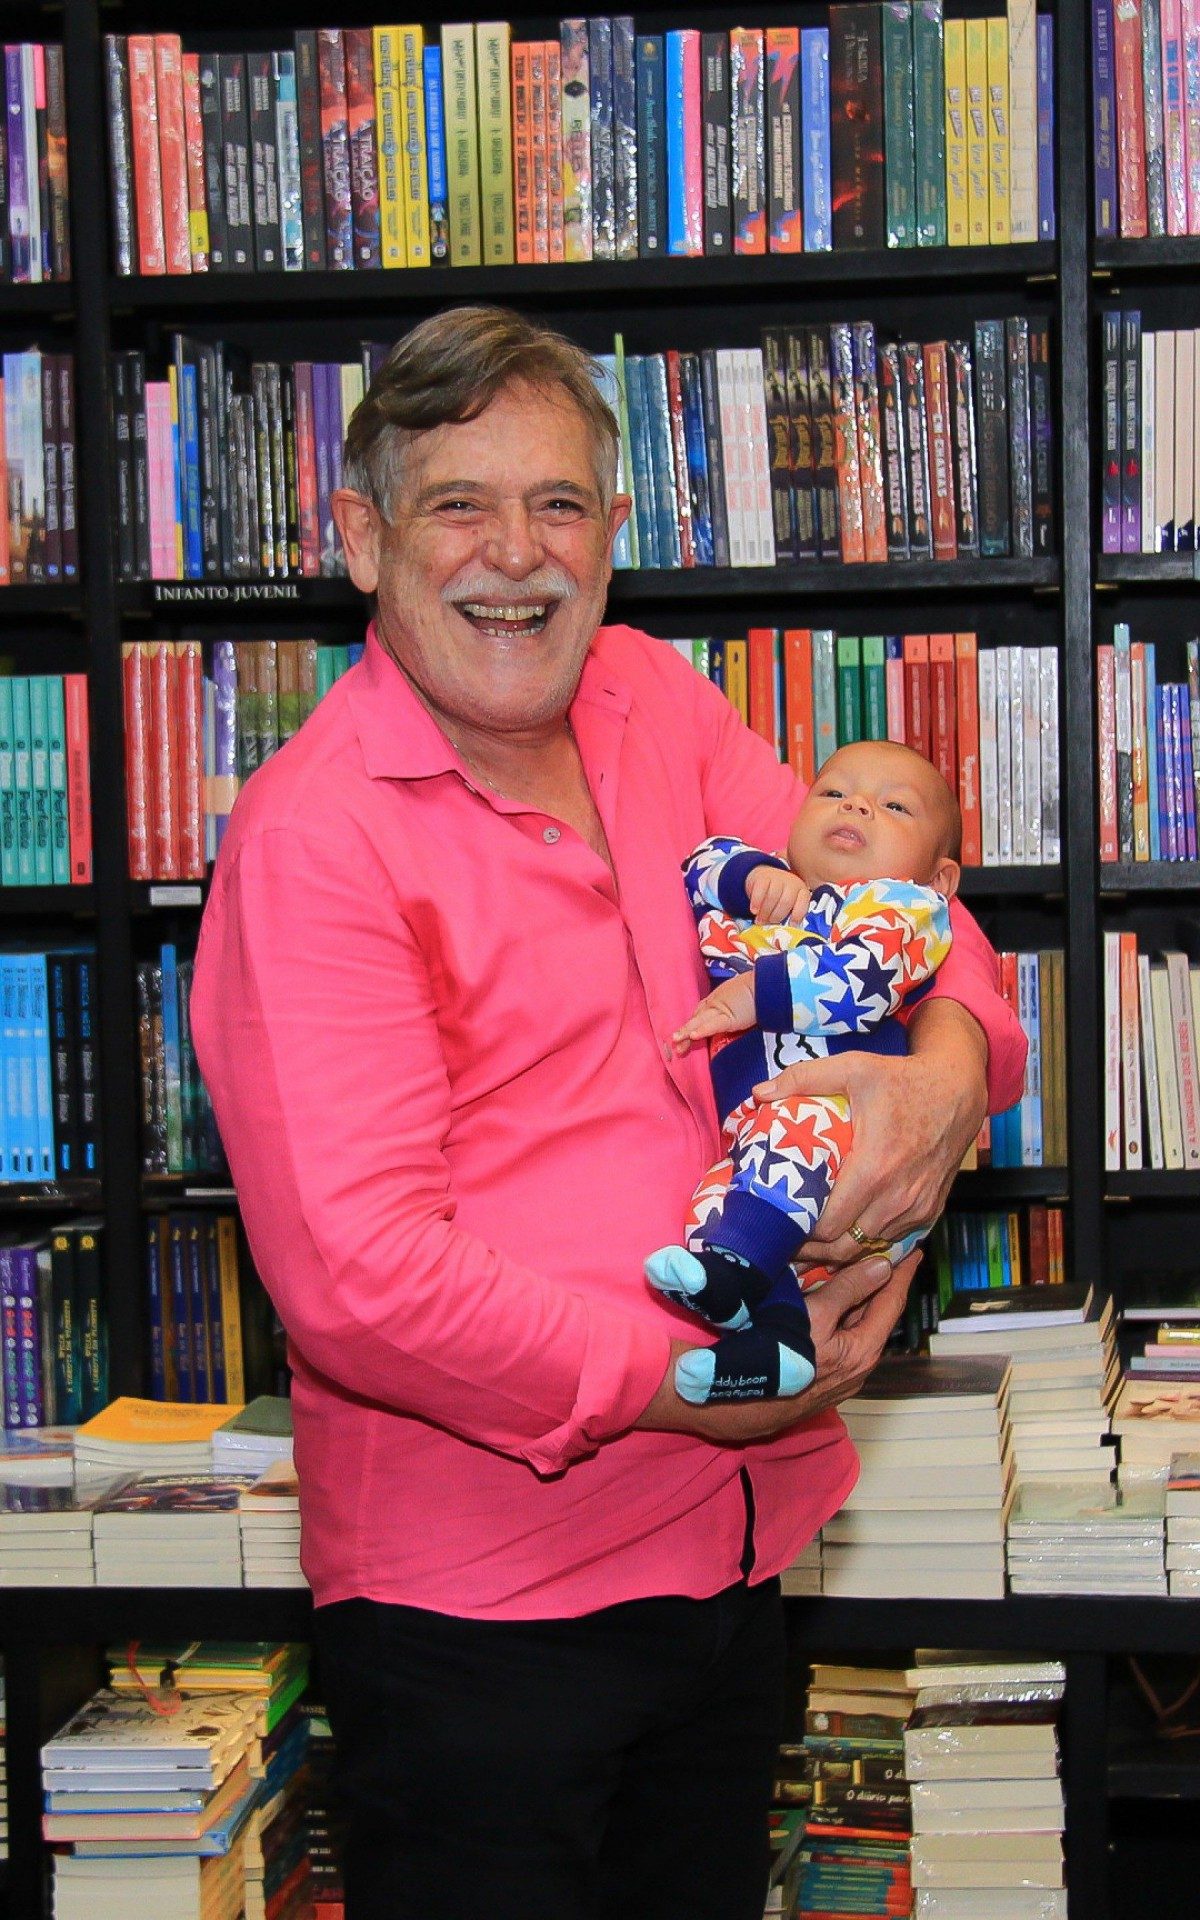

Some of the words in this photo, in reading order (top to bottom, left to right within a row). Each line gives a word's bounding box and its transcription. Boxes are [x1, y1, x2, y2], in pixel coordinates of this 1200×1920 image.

[359, 135, 376, 201] TRAIÇÃO
[934, 438, 947, 498] CHAMAS
[234, 585, 299, 602] JUVENIL
[715, 1375, 768, 1387] ddyboom
